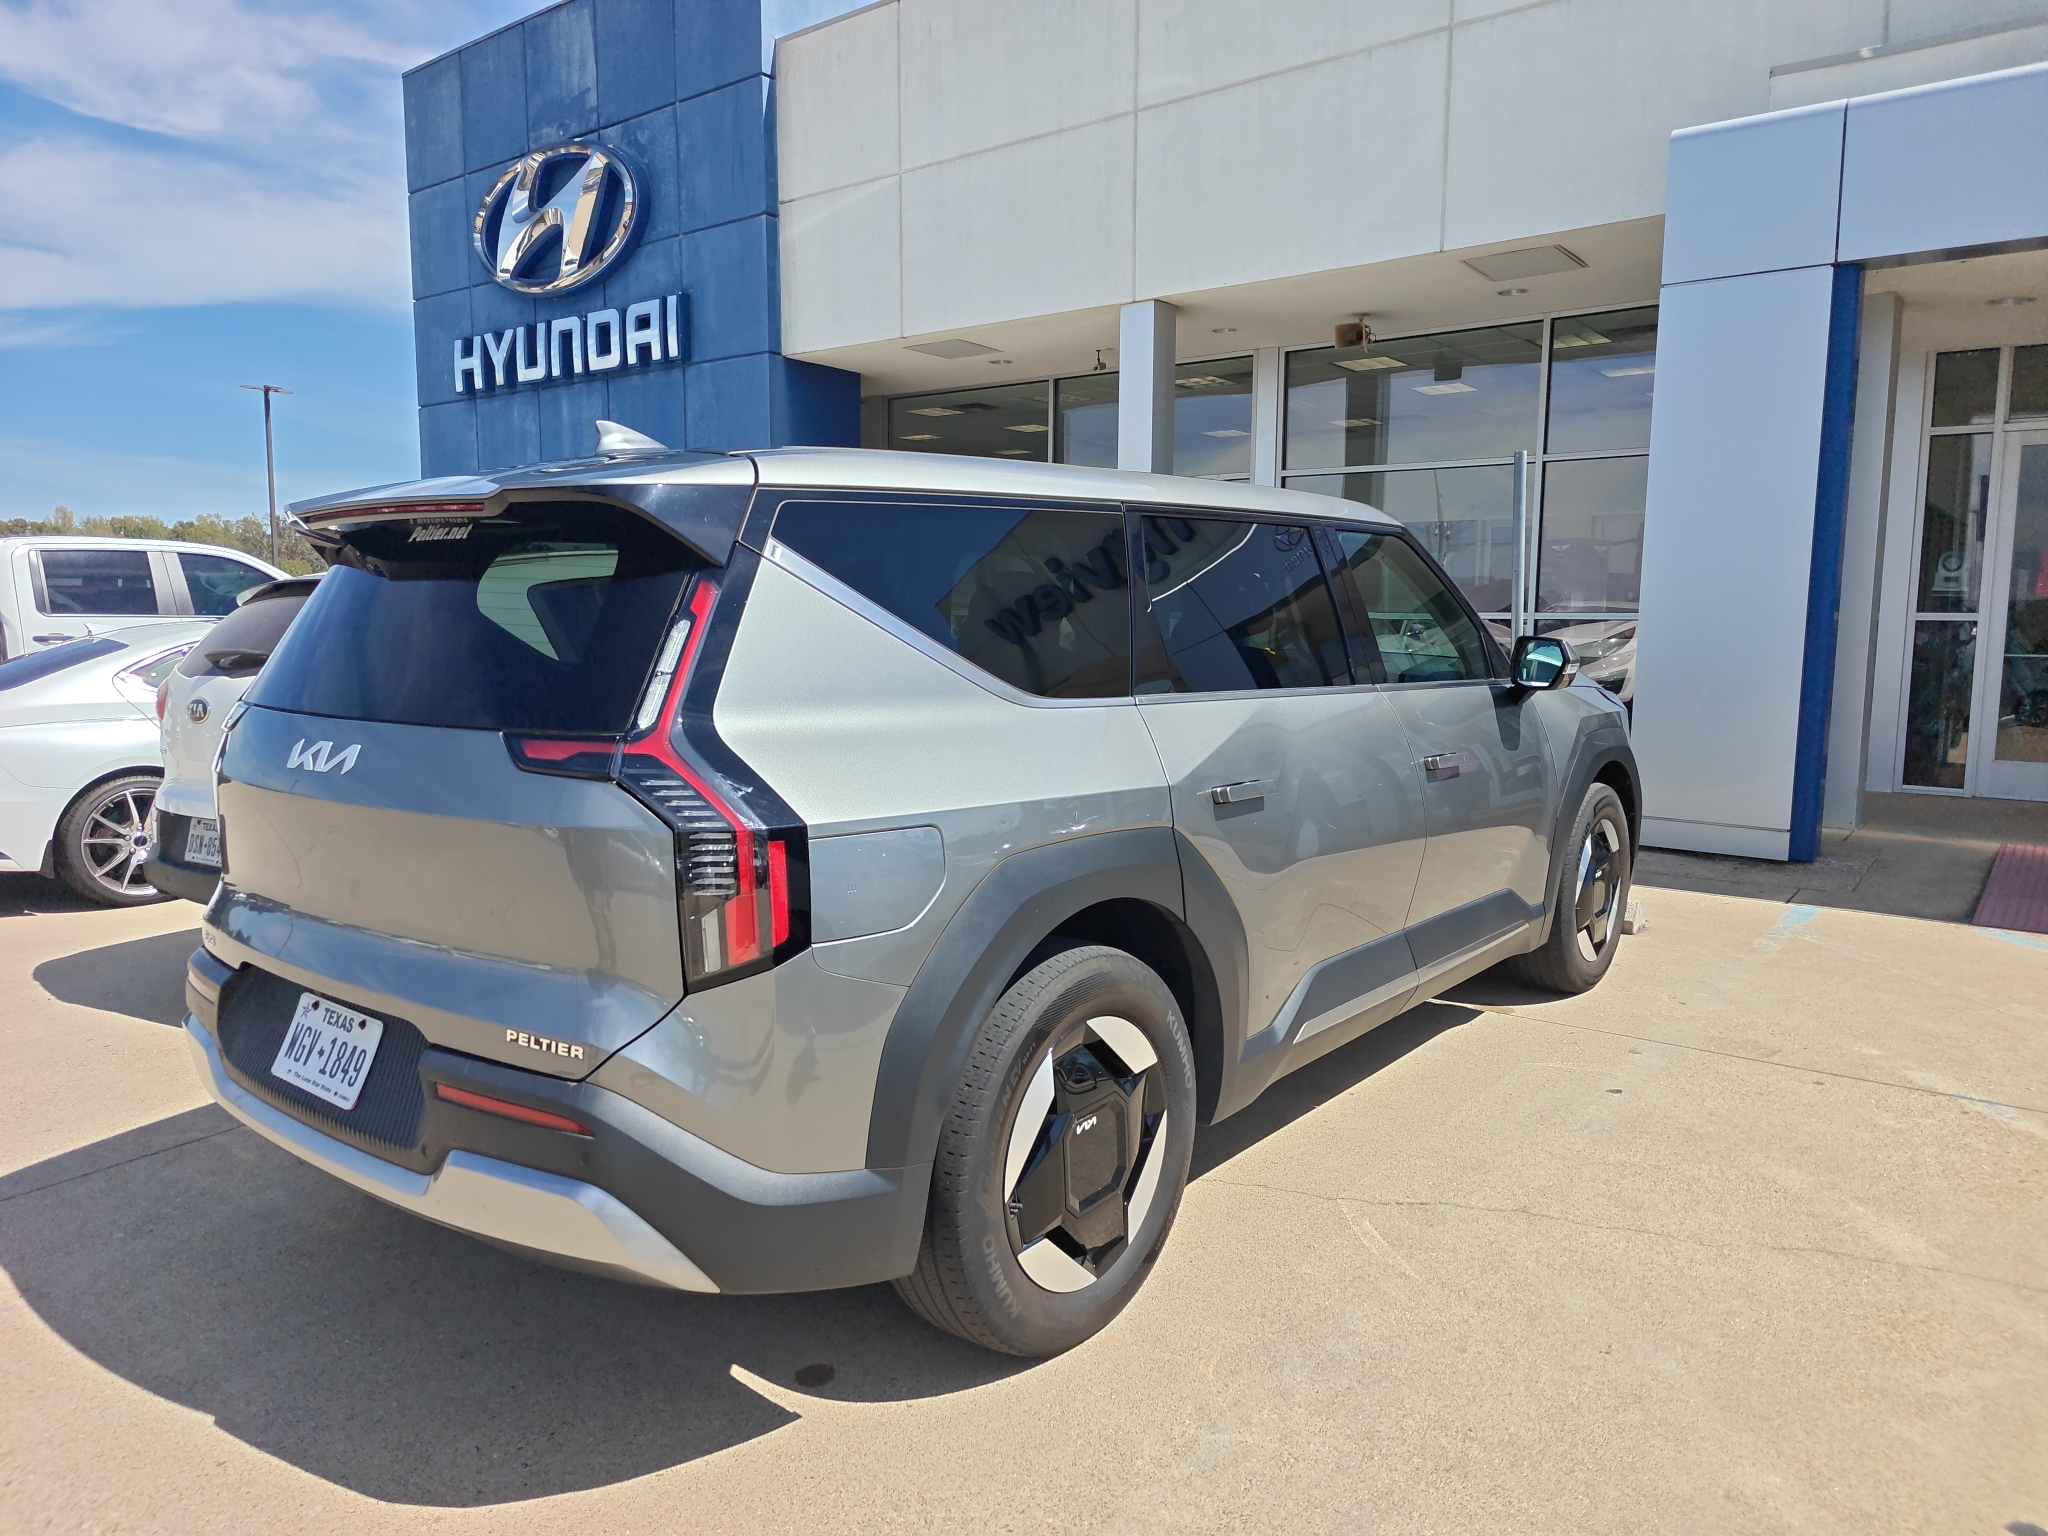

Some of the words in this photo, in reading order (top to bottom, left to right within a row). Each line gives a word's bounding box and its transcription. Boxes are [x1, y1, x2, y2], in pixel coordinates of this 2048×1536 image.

[454, 292, 684, 394] HYUNDAI
[408, 523, 473, 543] Peltier.net
[286, 738, 362, 775] KIA
[203, 822, 218, 832] TEXA
[322, 1007, 355, 1033] TEXAS
[505, 1029, 584, 1060] PELTIER
[1022, 1042, 1036, 1064] HP71
[1165, 1009, 1193, 1089] KUMHO
[320, 1083, 332, 1094] State
[982, 1238, 1020, 1320] KUMHO
